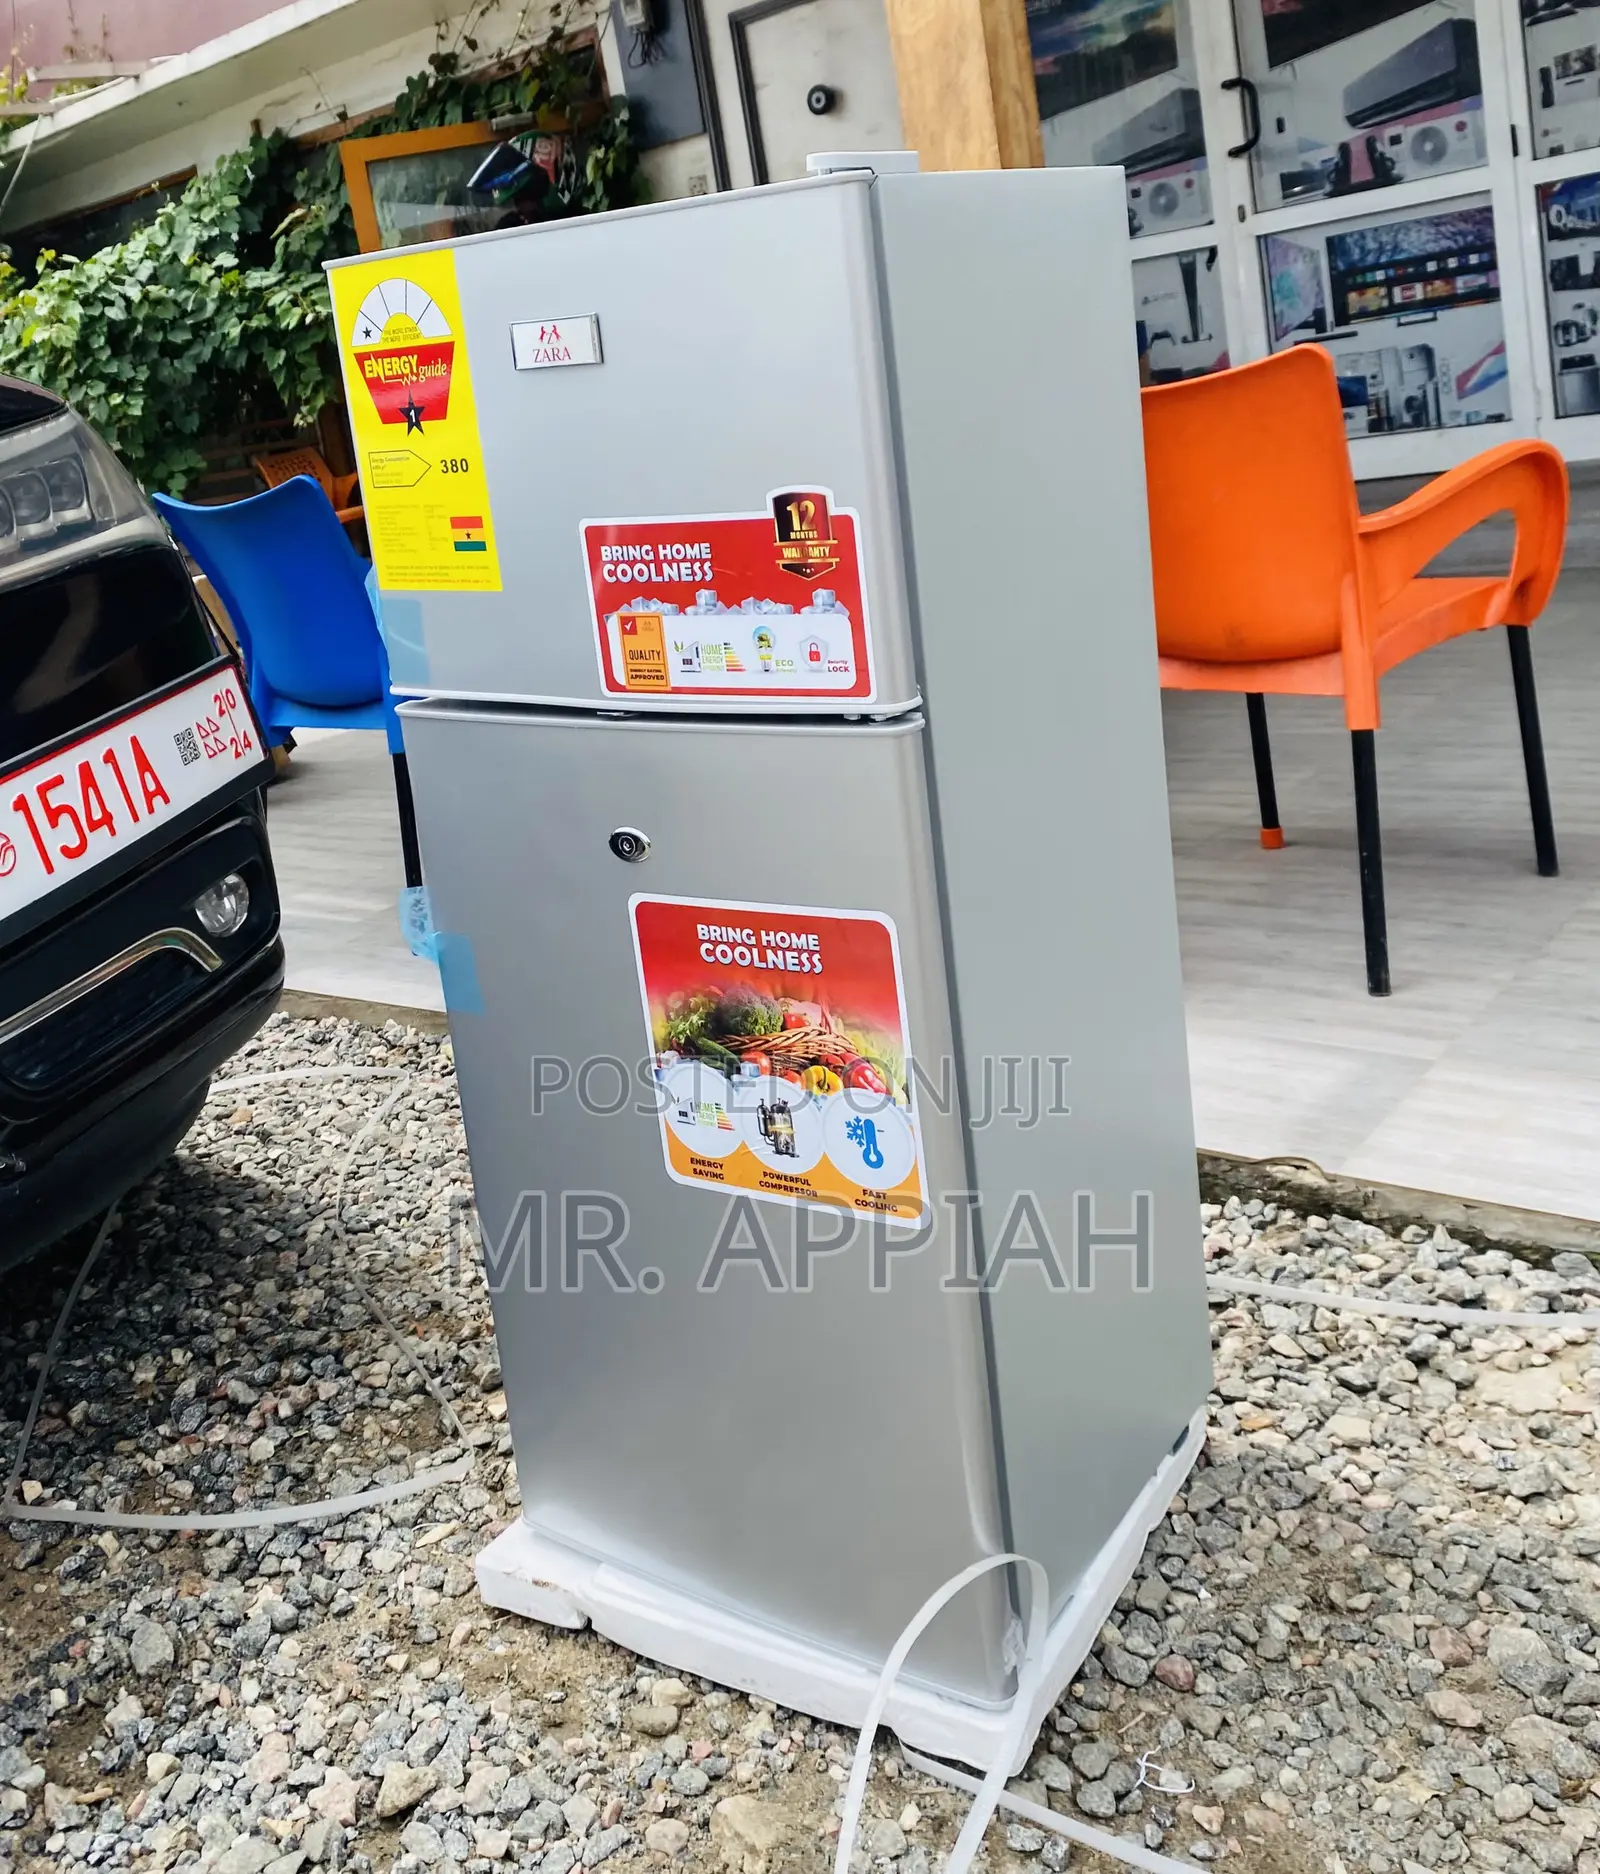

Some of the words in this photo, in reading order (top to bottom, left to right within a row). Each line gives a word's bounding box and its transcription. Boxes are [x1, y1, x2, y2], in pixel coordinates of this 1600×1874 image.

[532, 346, 572, 363] ZARA
[364, 353, 418, 384] ENERGY
[418, 358, 447, 382] guide
[409, 409, 416, 423] 1
[440, 458, 469, 474] 380
[786, 500, 816, 531] 12
[790, 530, 818, 540] MONTHS
[600, 545, 655, 562] BRING
[658, 543, 712, 560] HOME
[782, 546, 830, 559] WARRANTY
[602, 561, 714, 583] COOLNESS
[628, 650, 661, 661] QUALITY
[701, 643, 723, 655] HOME
[775, 659, 794, 667] ECO
[827, 665, 850, 673] LOCK
[11, 735, 171, 875] 1541A
[696, 924, 757, 945] BRING
[760, 929, 820, 951] HOME
[699, 942, 823, 974] COOLNESS
[690, 1157, 724, 1171] ENERGY
[693, 1168, 725, 1180] SAVING
[763, 1171, 812, 1187] POWERFUL
[758, 1180, 819, 1198] COMPRESSOR
[862, 1189, 888, 1200] FAST
[854, 1198, 899, 1213] COOLING
